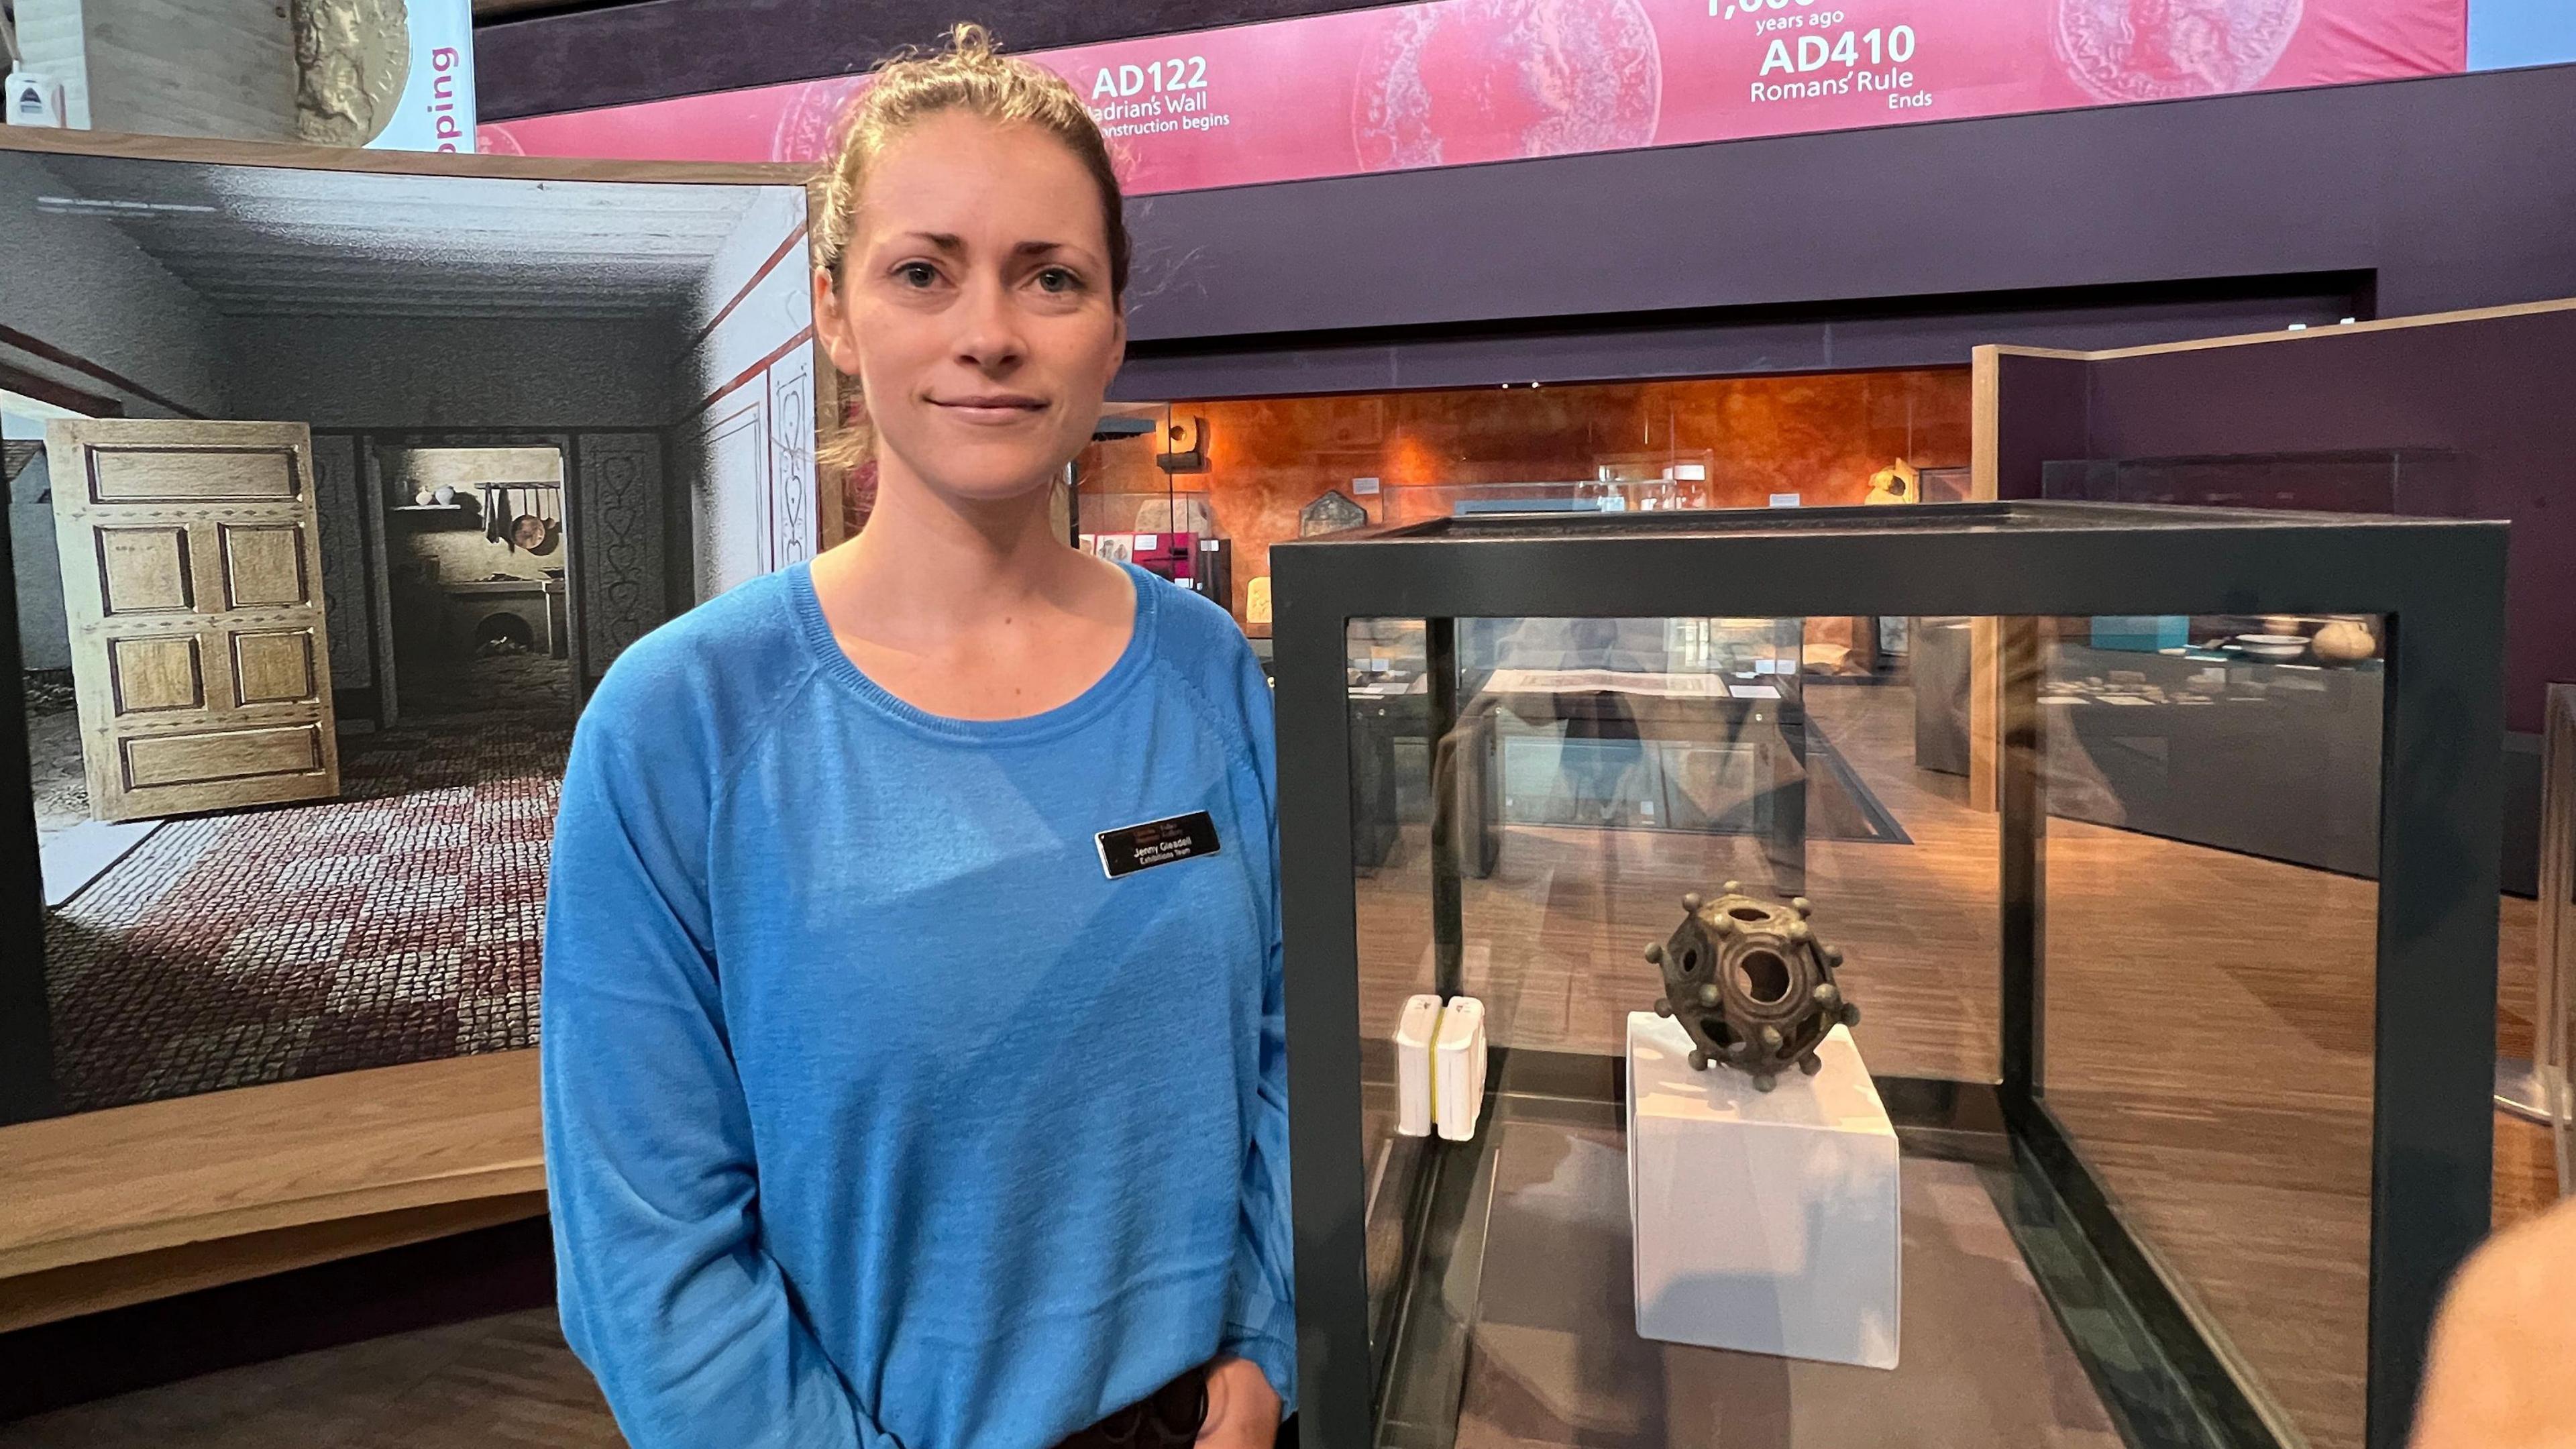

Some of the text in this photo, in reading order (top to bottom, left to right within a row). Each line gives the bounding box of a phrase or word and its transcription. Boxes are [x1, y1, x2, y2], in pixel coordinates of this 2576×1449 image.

[1756, 12, 1804, 36] years
[1809, 10, 1845, 29] ago
[1759, 25, 1915, 76] AD410
[1091, 56, 1208, 99] AD122
[1751, 67, 1913, 102] Romans' Rule
[1165, 91, 1207, 113] Wall
[1888, 91, 1933, 109] Ends
[1102, 113, 1230, 138] onstruction begins
[1134, 845, 1159, 858] Jenny
